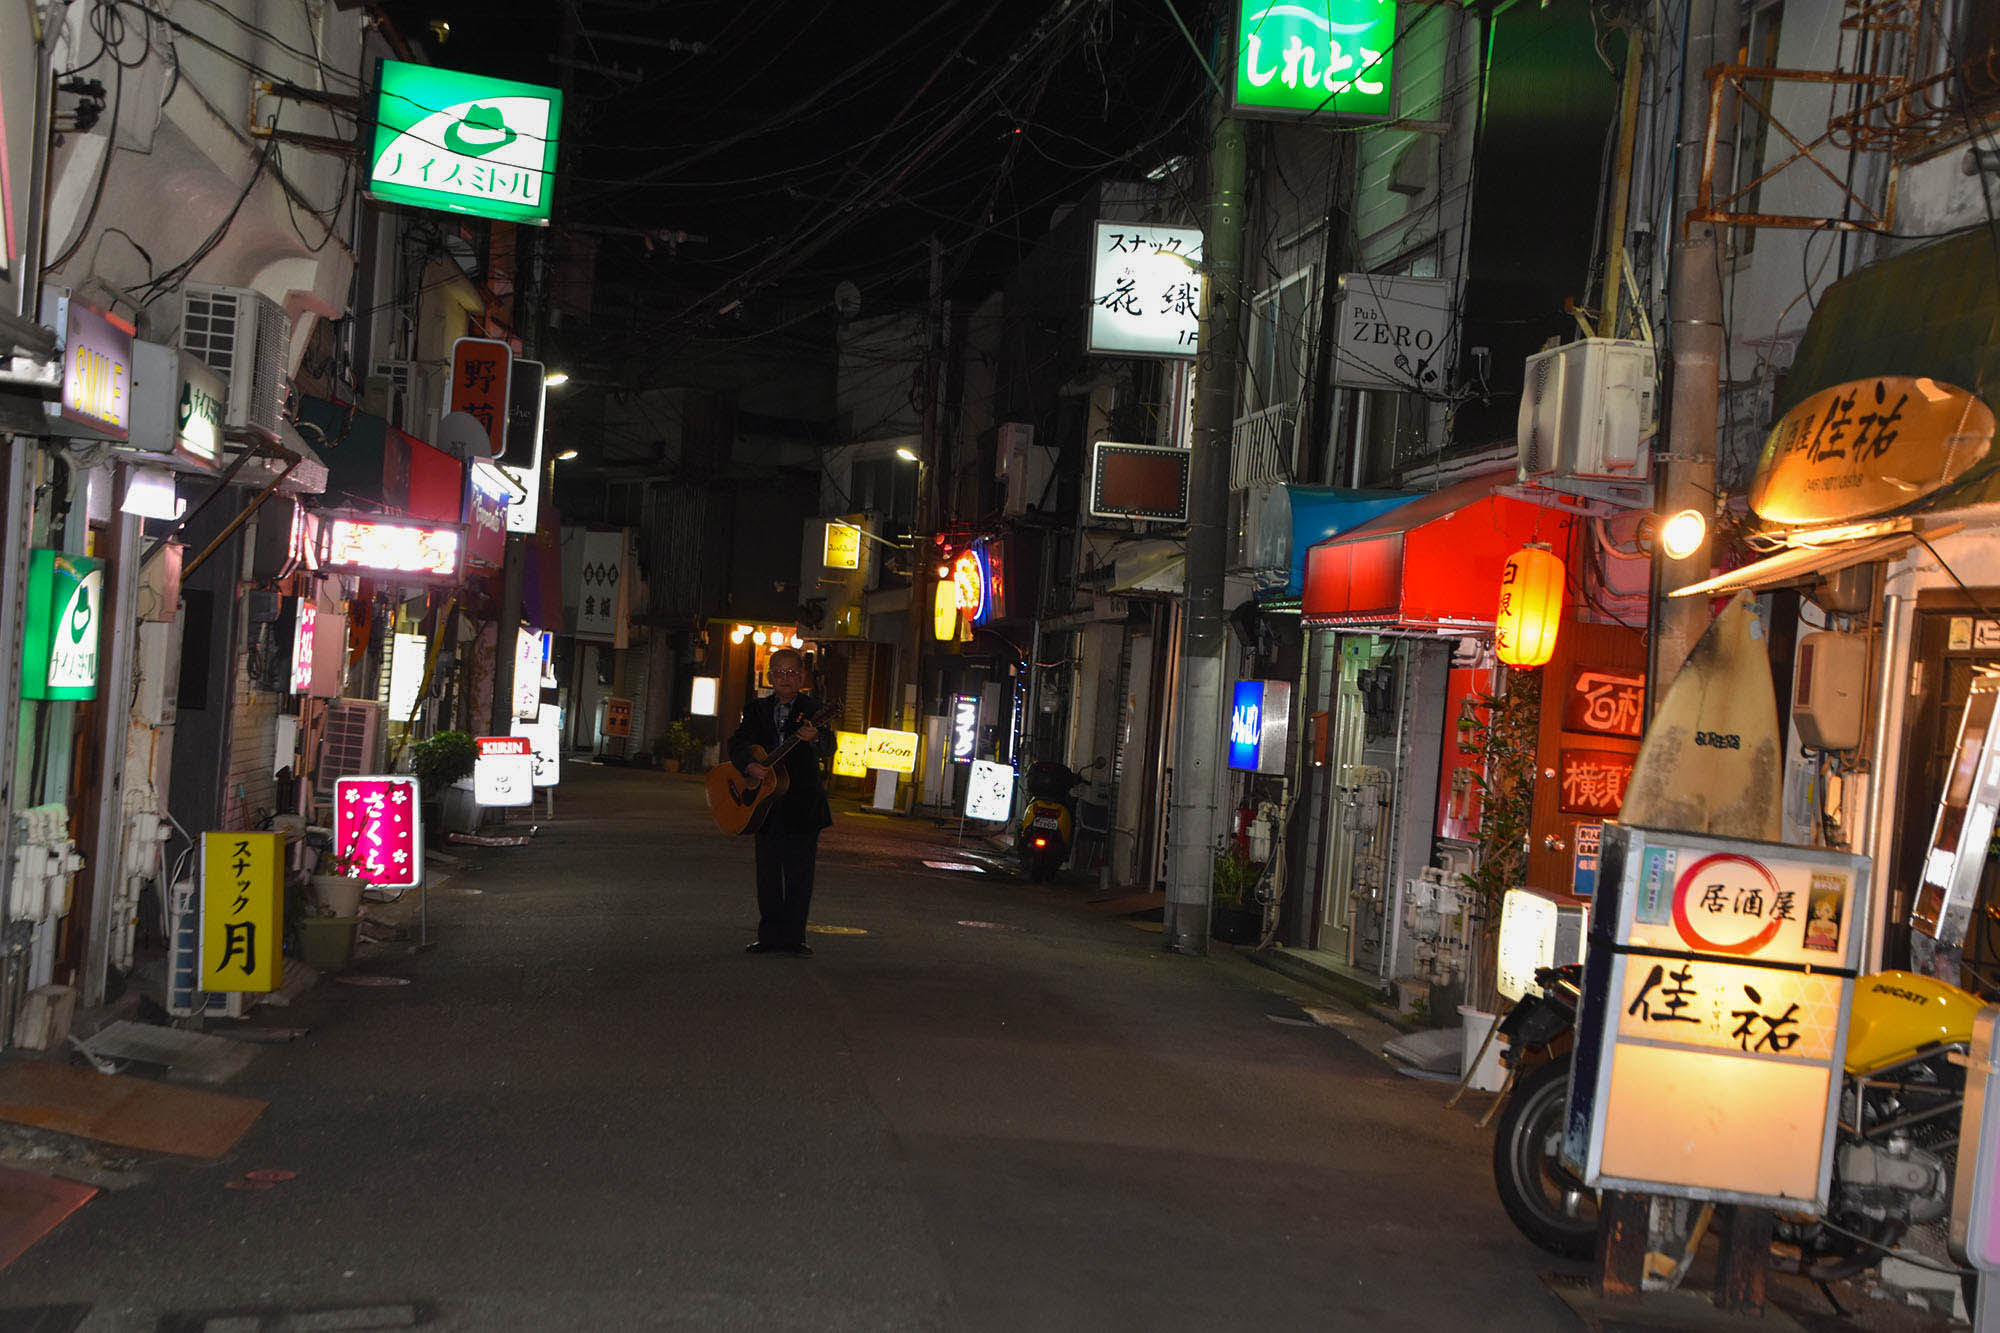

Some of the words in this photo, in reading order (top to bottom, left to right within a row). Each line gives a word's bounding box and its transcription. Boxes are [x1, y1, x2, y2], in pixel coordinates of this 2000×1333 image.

[1247, 33, 1384, 95] しれとこ
[1108, 233, 1183, 255] スナック
[1353, 306, 1378, 321] Pub
[1178, 329, 1198, 346] 1F
[1352, 321, 1433, 351] ZERO
[73, 344, 122, 426] SMILE
[482, 741, 524, 755] KIRIN
[869, 740, 912, 757] Moon
[363, 791, 386, 877] さくら
[231, 840, 253, 916] スナック
[1700, 884, 1797, 922] 居酒屋
[215, 920, 256, 977] 月
[1628, 964, 1801, 1053] 佳祐
[1872, 983, 1929, 1006] DUCATI
